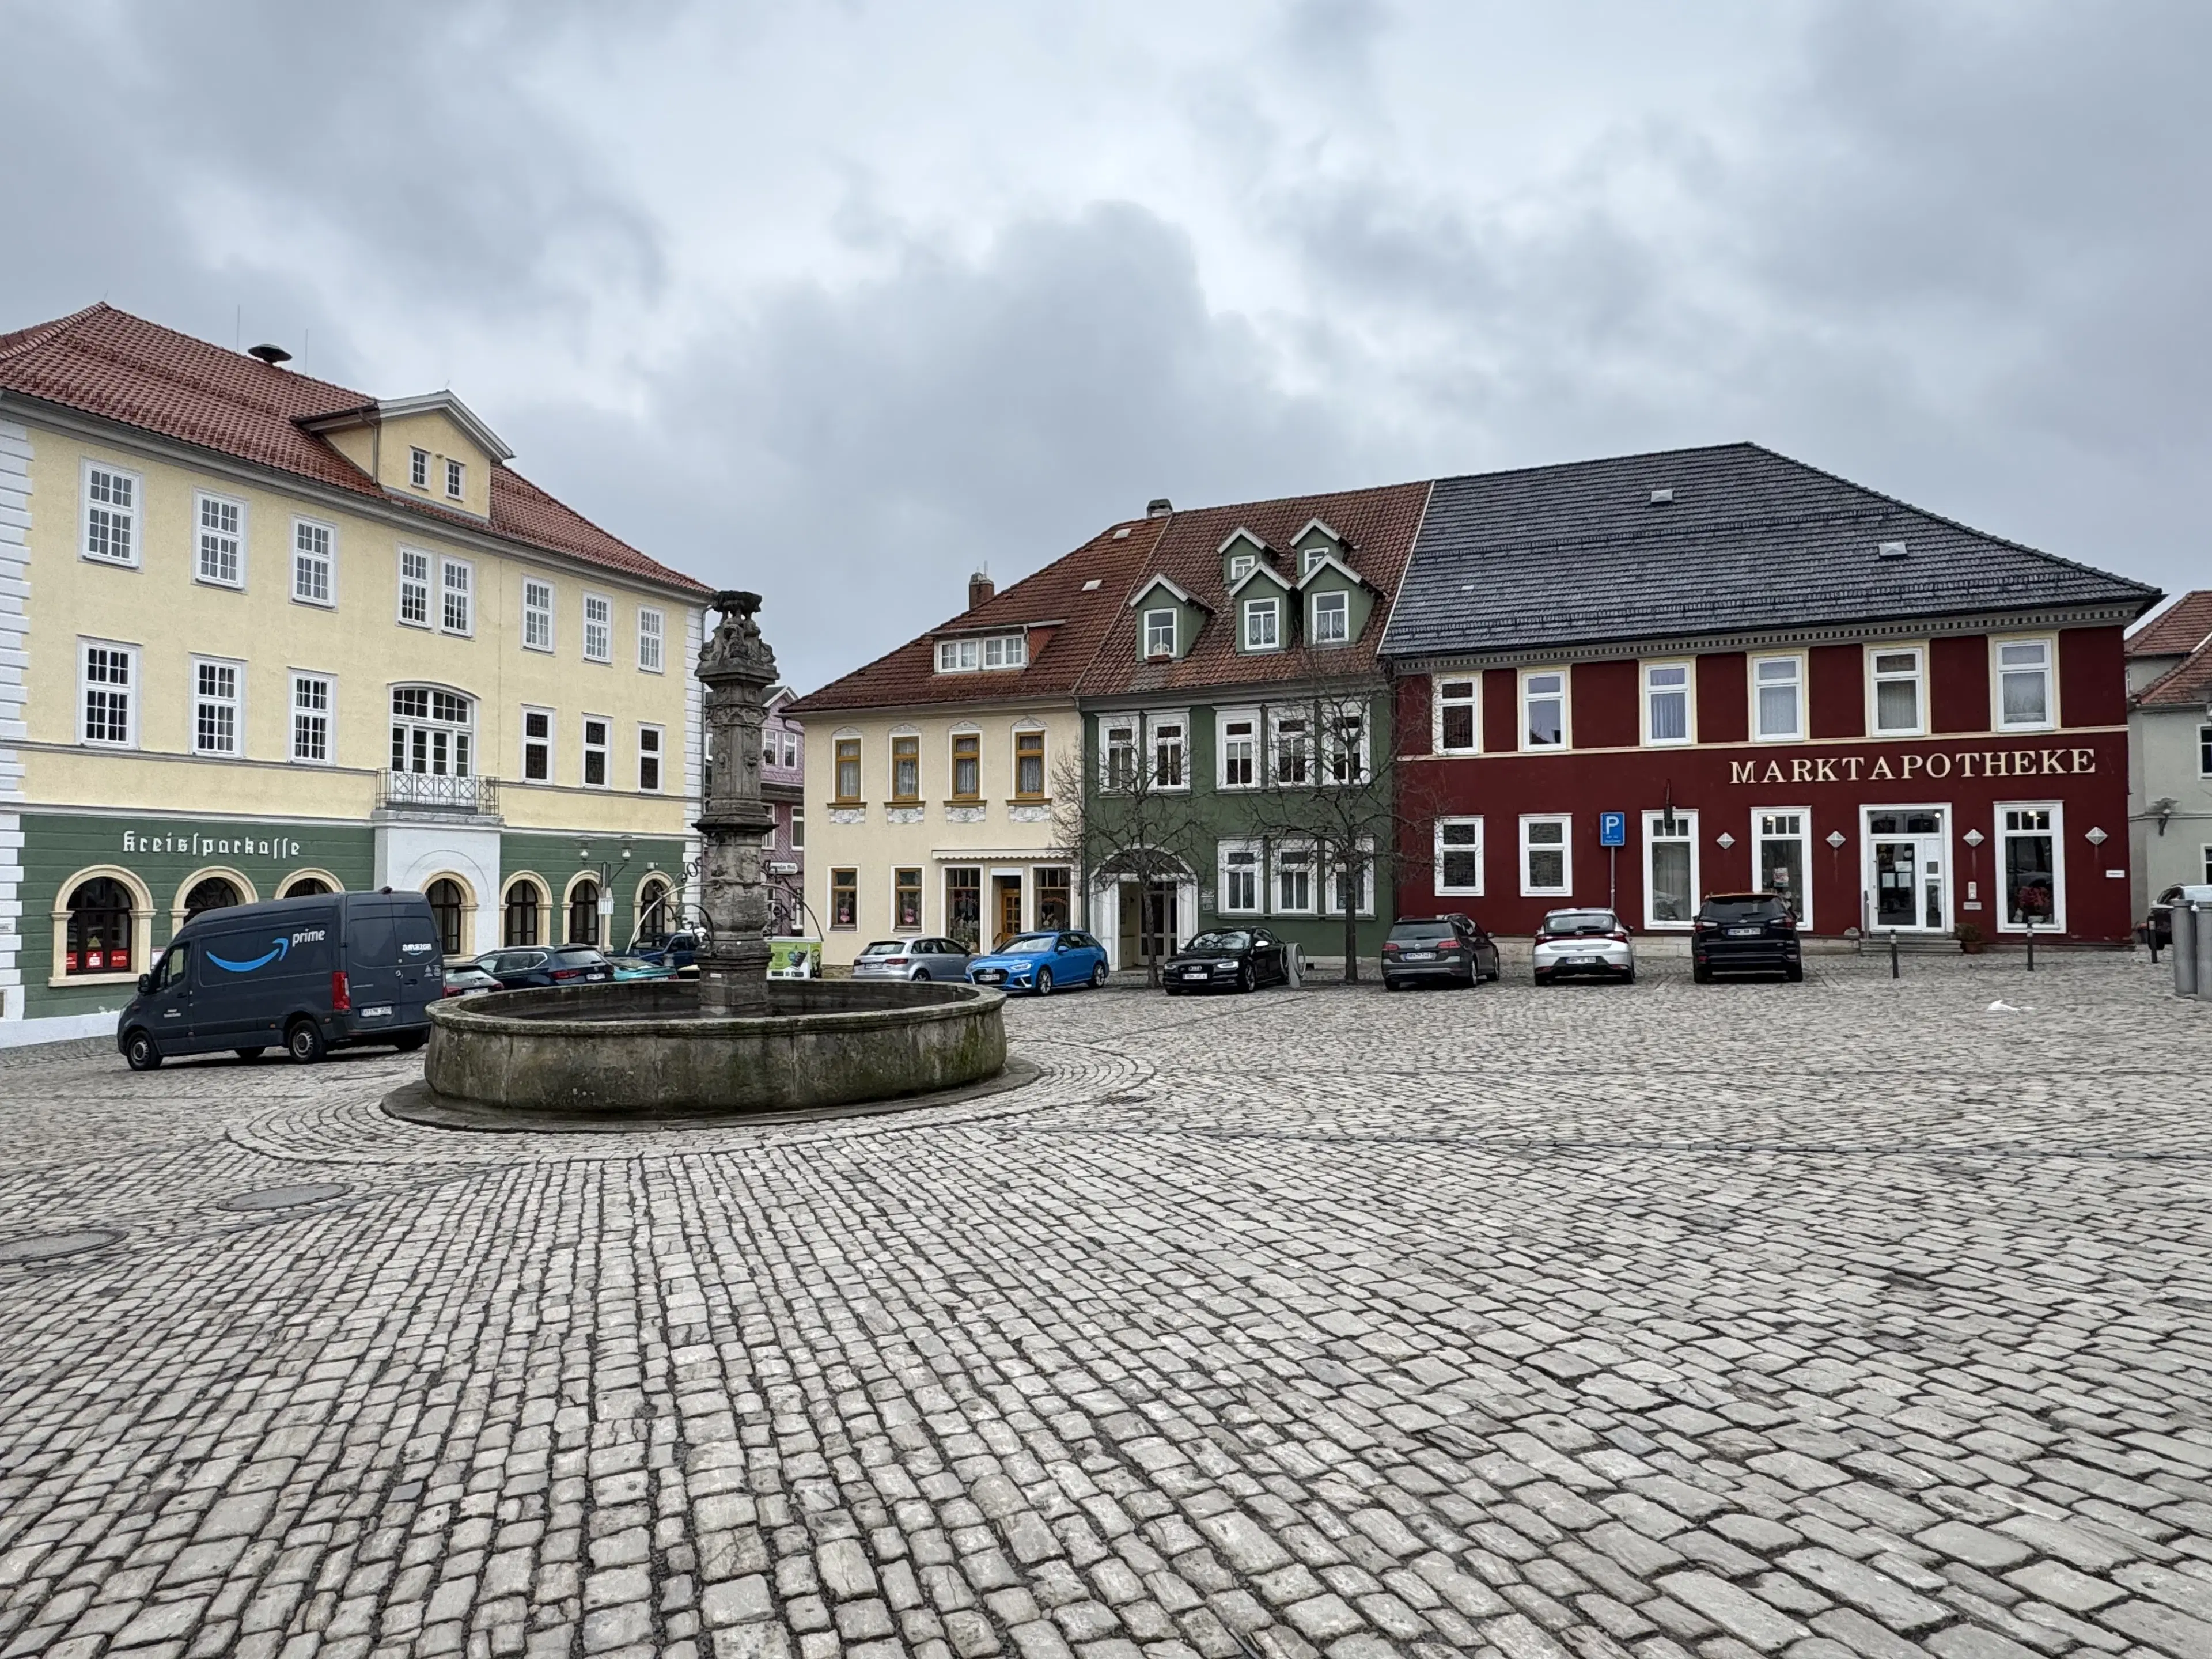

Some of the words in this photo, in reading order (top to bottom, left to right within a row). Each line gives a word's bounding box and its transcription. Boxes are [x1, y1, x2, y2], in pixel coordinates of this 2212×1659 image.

[1606, 816, 1619, 835] P
[291, 928, 325, 948] prime
[402, 943, 432, 952] amazon
